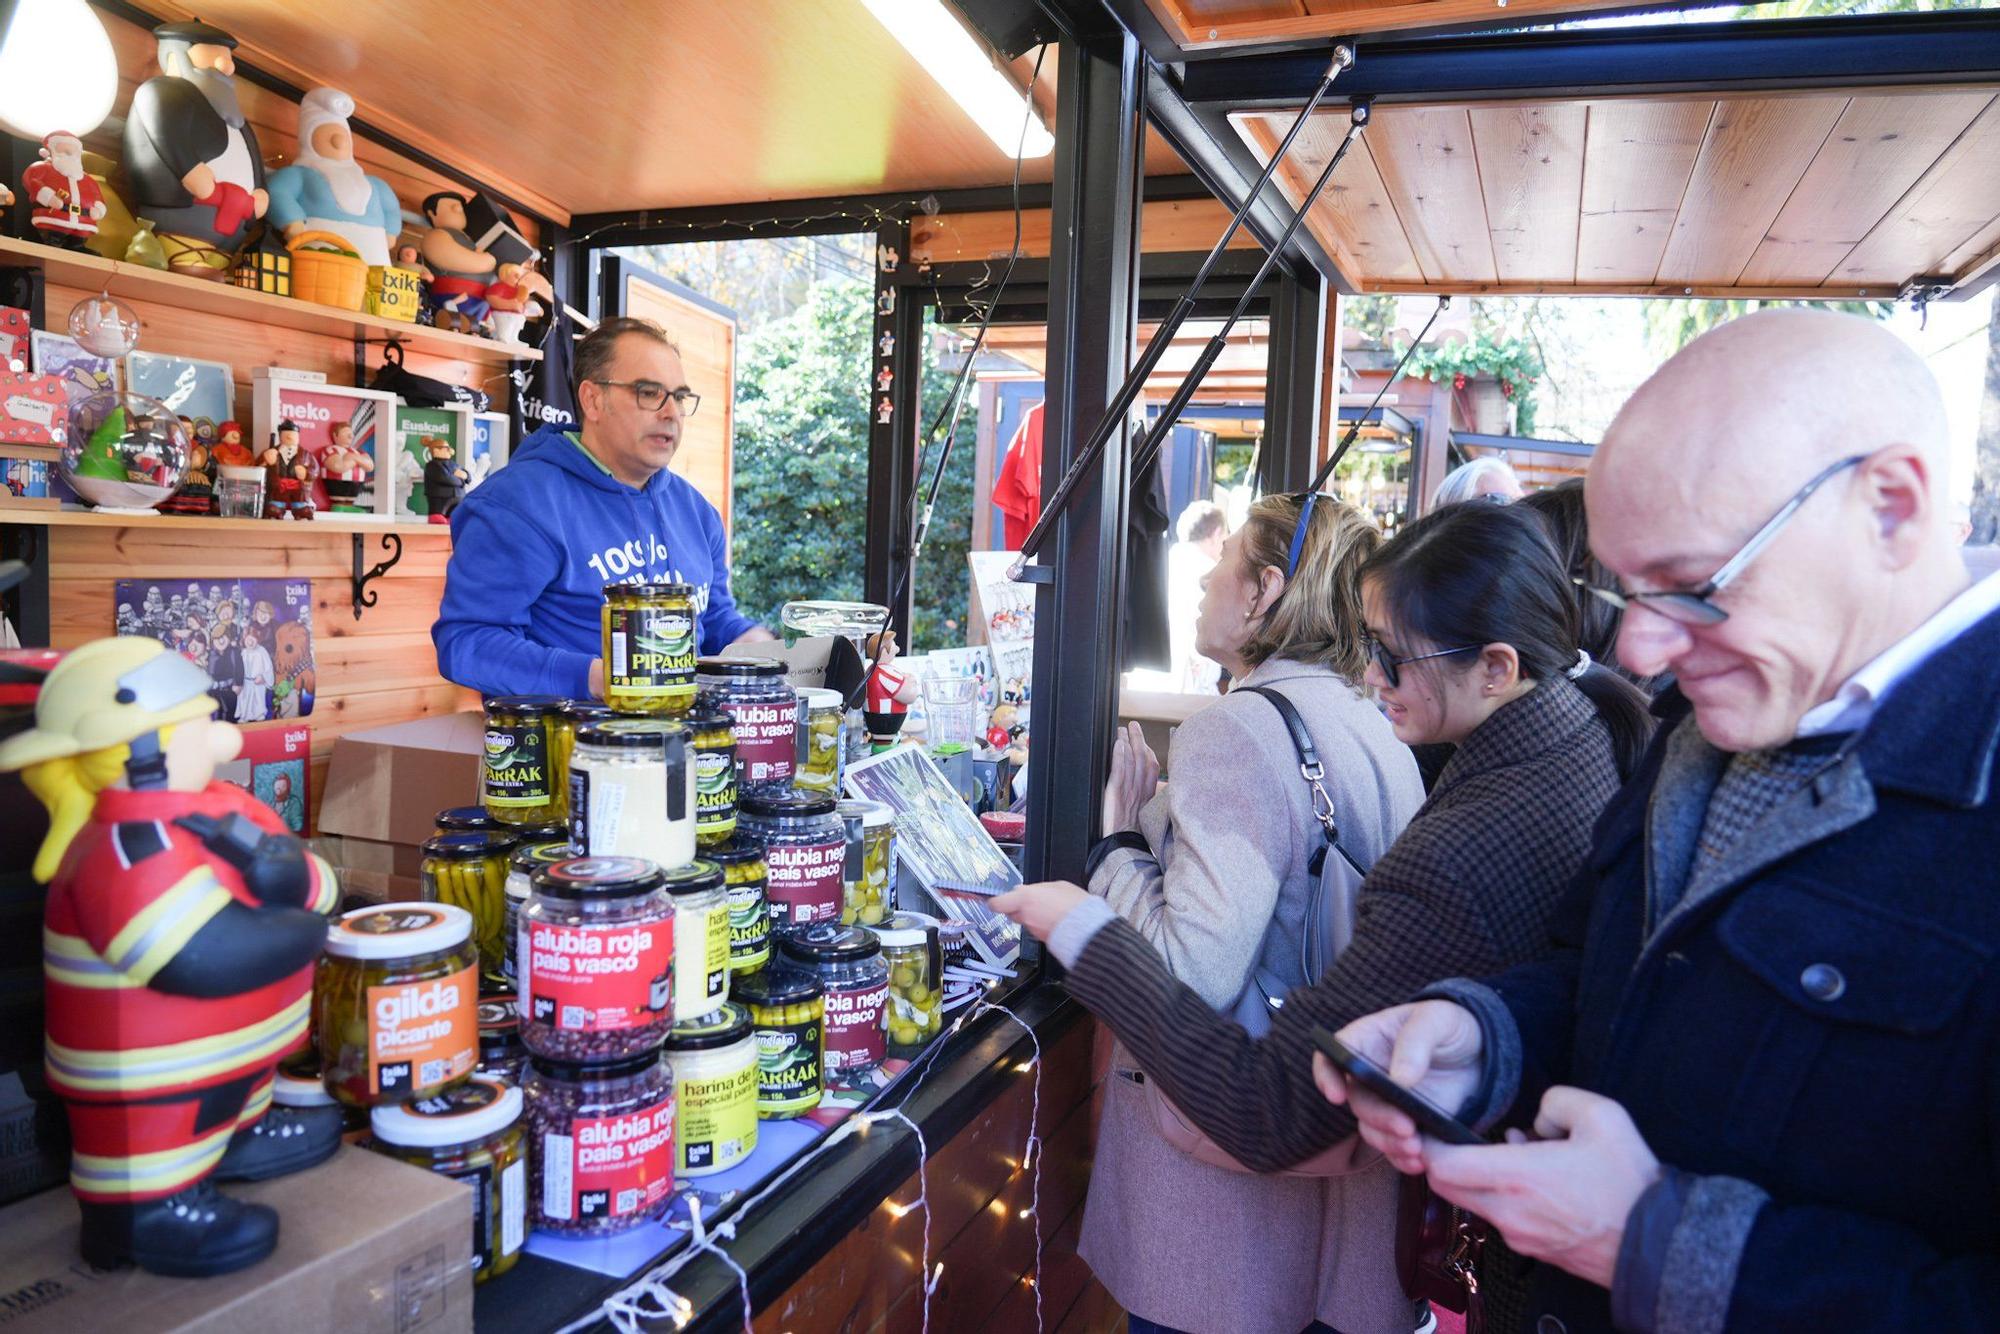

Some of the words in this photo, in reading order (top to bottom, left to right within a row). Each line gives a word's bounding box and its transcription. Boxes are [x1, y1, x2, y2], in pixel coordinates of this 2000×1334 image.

[383, 271, 420, 293] txiki
[279, 400, 331, 420] neko
[402, 419, 450, 434] Euskadi
[760, 724, 794, 737] vasco
[768, 849, 823, 866] alubia
[767, 866, 802, 883] país
[804, 862, 840, 879] vasco
[533, 928, 602, 955] alubia
[607, 928, 653, 956] roja
[533, 950, 571, 973] país
[574, 955, 639, 974] vasco
[375, 981, 459, 1030] gilda
[824, 993, 853, 1012] bia
[833, 1008, 876, 1026] vasco
[375, 1019, 452, 1054] picante
[685, 1079, 735, 1097] harina
[736, 1070, 752, 1087] de
[685, 1090, 732, 1108] especial
[579, 1115, 651, 1145] alubia
[578, 1141, 624, 1169] país
[627, 1125, 673, 1157] vasco
